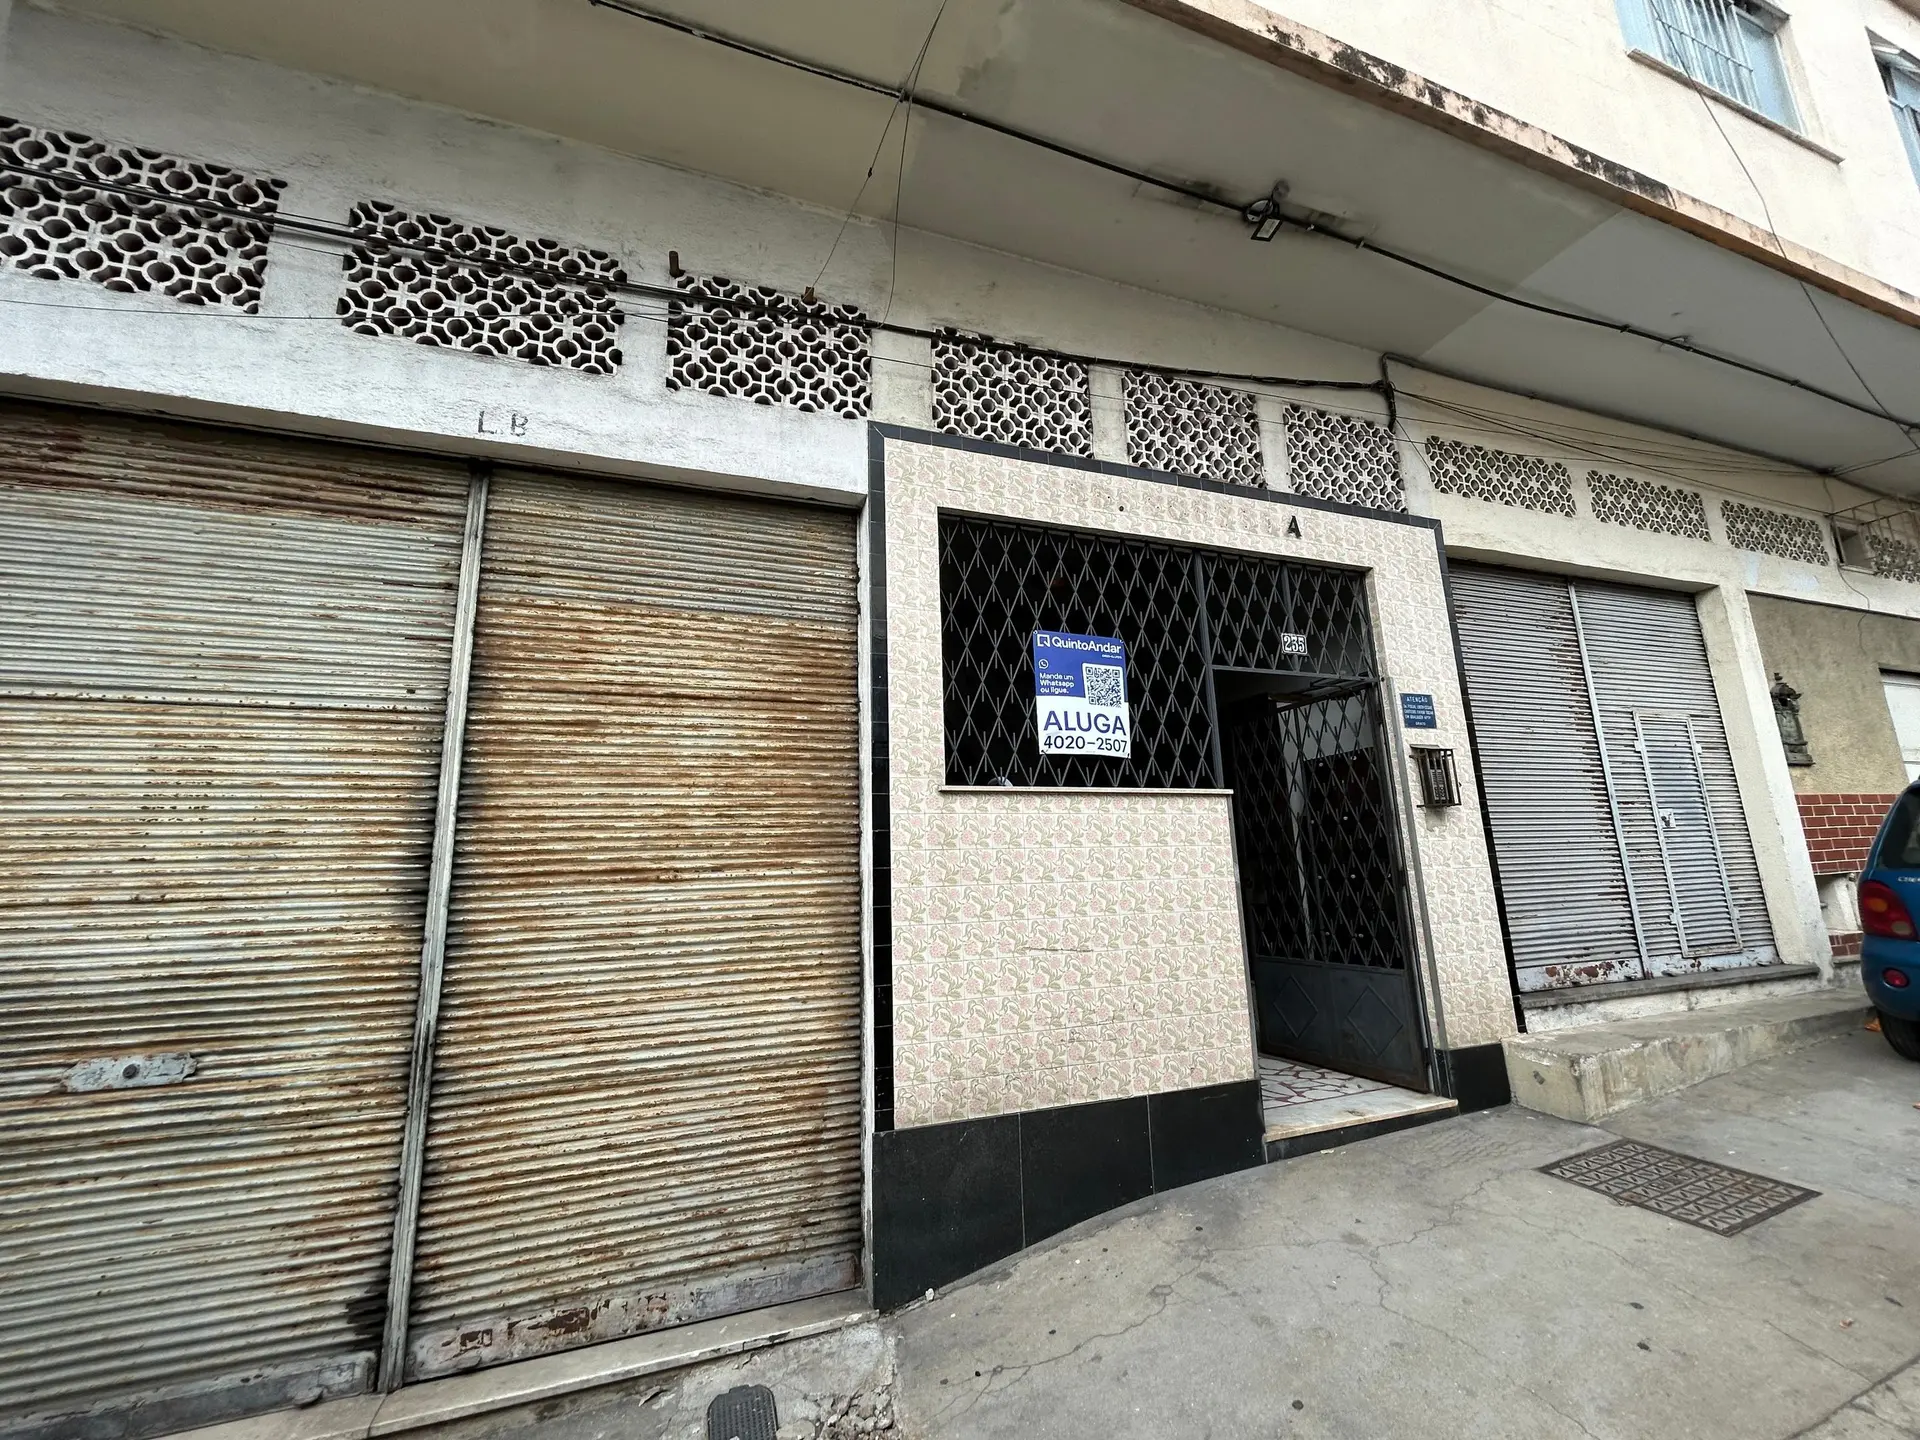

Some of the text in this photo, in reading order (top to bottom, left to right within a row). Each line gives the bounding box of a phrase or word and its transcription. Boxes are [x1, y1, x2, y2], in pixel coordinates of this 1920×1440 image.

[1287, 515, 1302, 539] A
[1052, 636, 1122, 654] QuintoAndar
[1283, 635, 1305, 653] 235
[1039, 680, 1075, 688] Whatsapp
[1050, 686, 1069, 695] ligue.
[1043, 710, 1126, 736] ALUGA
[1043, 735, 1128, 753] 4020-2507
